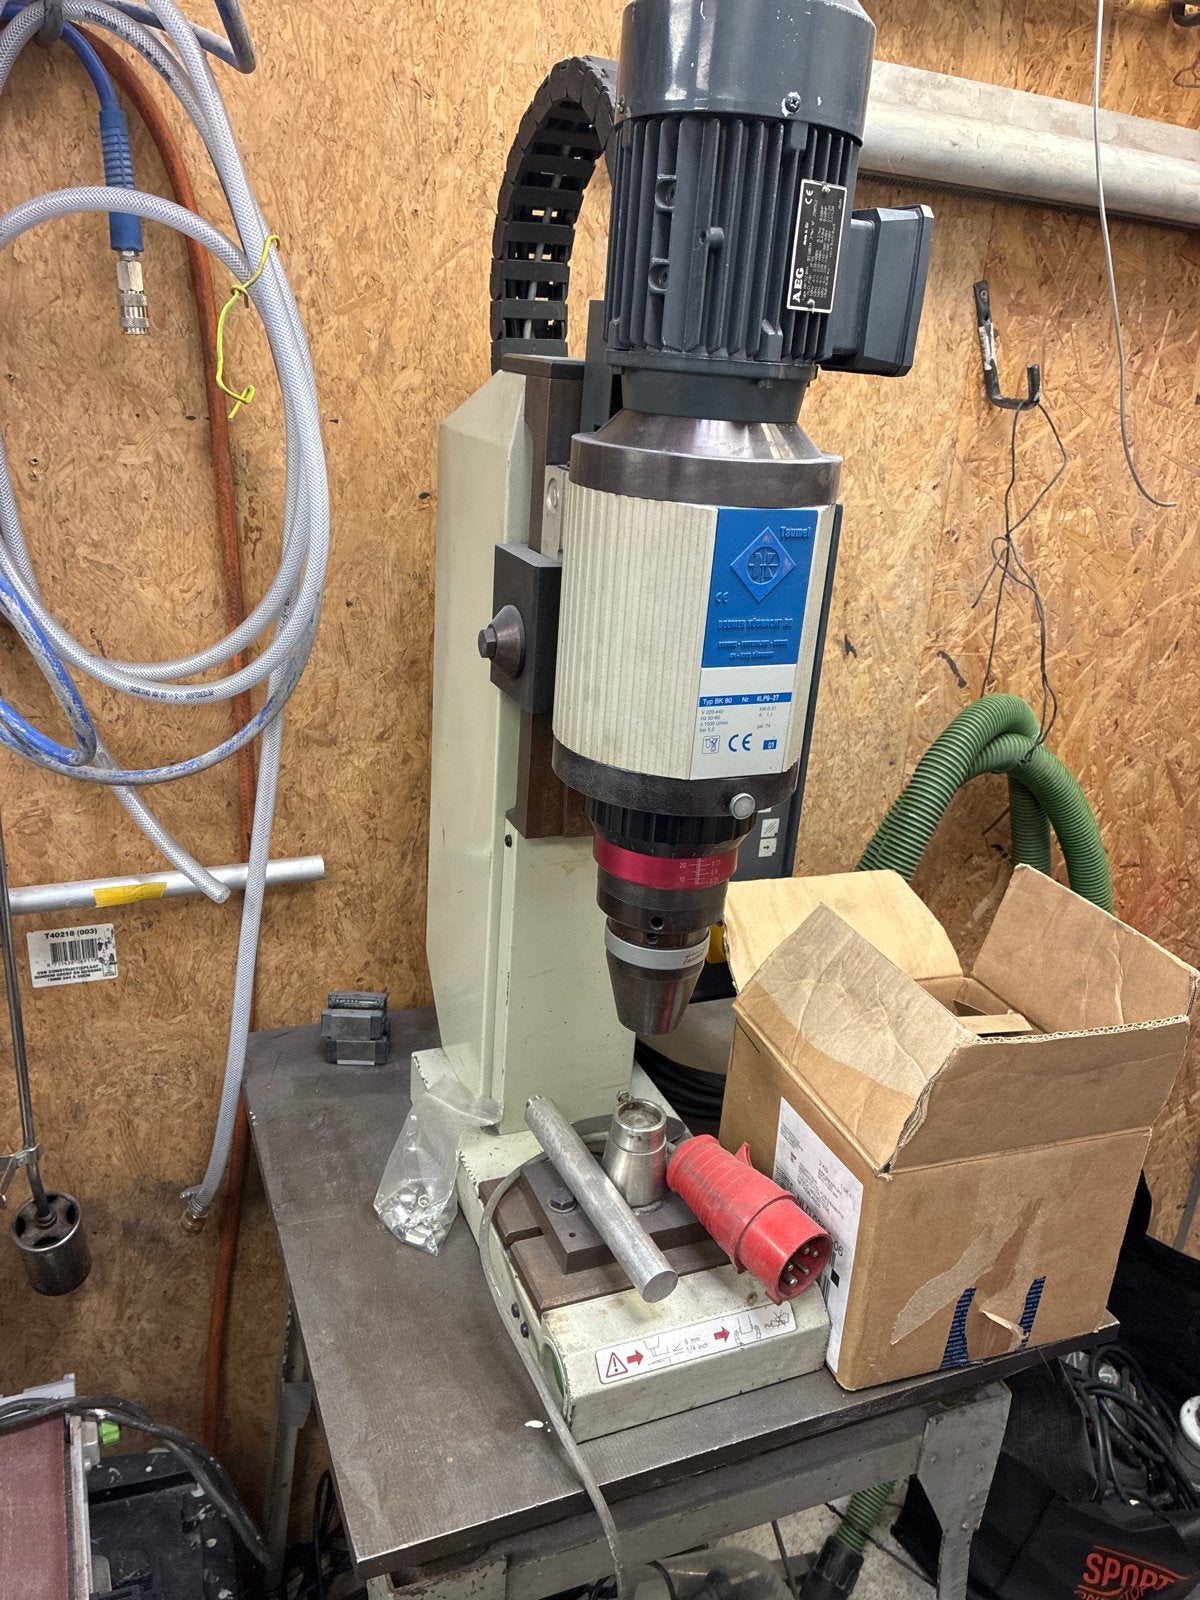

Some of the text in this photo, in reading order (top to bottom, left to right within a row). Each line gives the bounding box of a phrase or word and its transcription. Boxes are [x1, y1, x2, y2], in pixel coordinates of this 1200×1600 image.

[792, 267, 804, 303] AEG
[780, 526, 811, 540] Taumel
[44, 928, 98, 939] T40218 (003)
